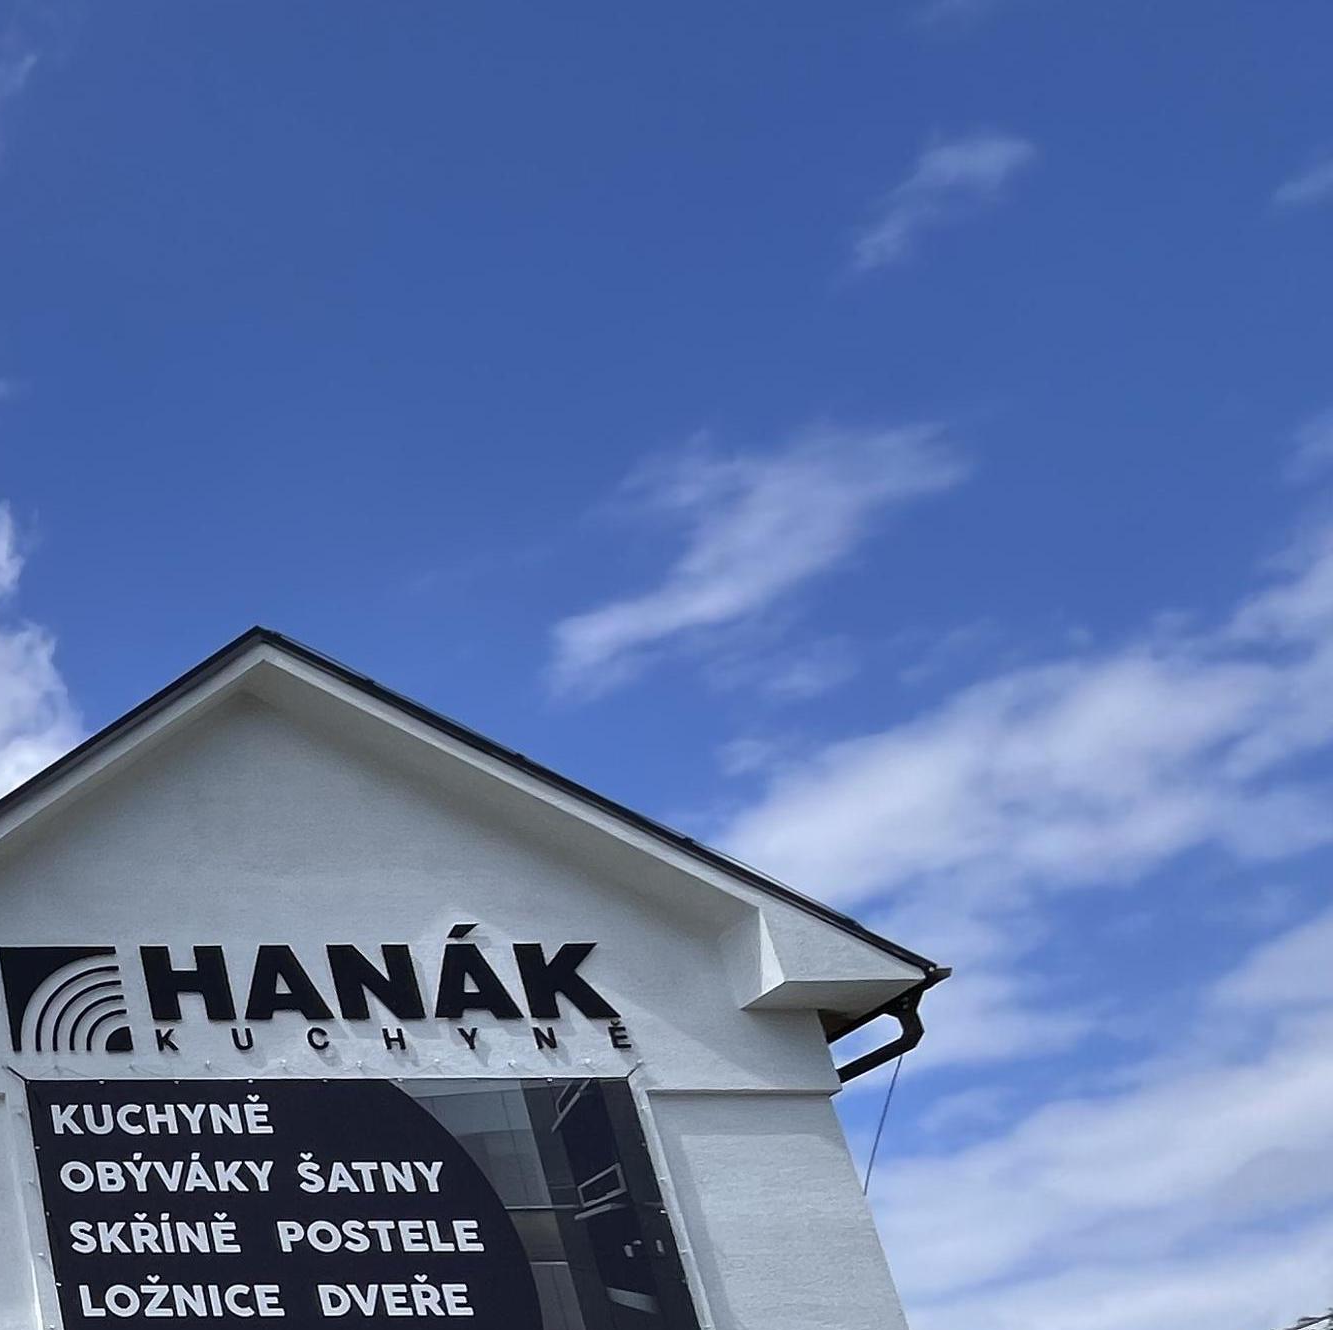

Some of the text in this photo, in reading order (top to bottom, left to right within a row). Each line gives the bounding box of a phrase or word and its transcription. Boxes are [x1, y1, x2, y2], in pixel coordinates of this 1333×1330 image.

[139, 922, 622, 1020] HANÁK
[154, 1019, 632, 1052] KUCHYNĚ
[49, 1093, 275, 1135] KUCHYNĚ
[59, 1151, 444, 1193] OBÝVÁKY ŠATNY
[69, 1211, 485, 1253] SKŘÍNĚ POSTELE
[77, 1273, 474, 1317] LOŽNICE DVEŘE
